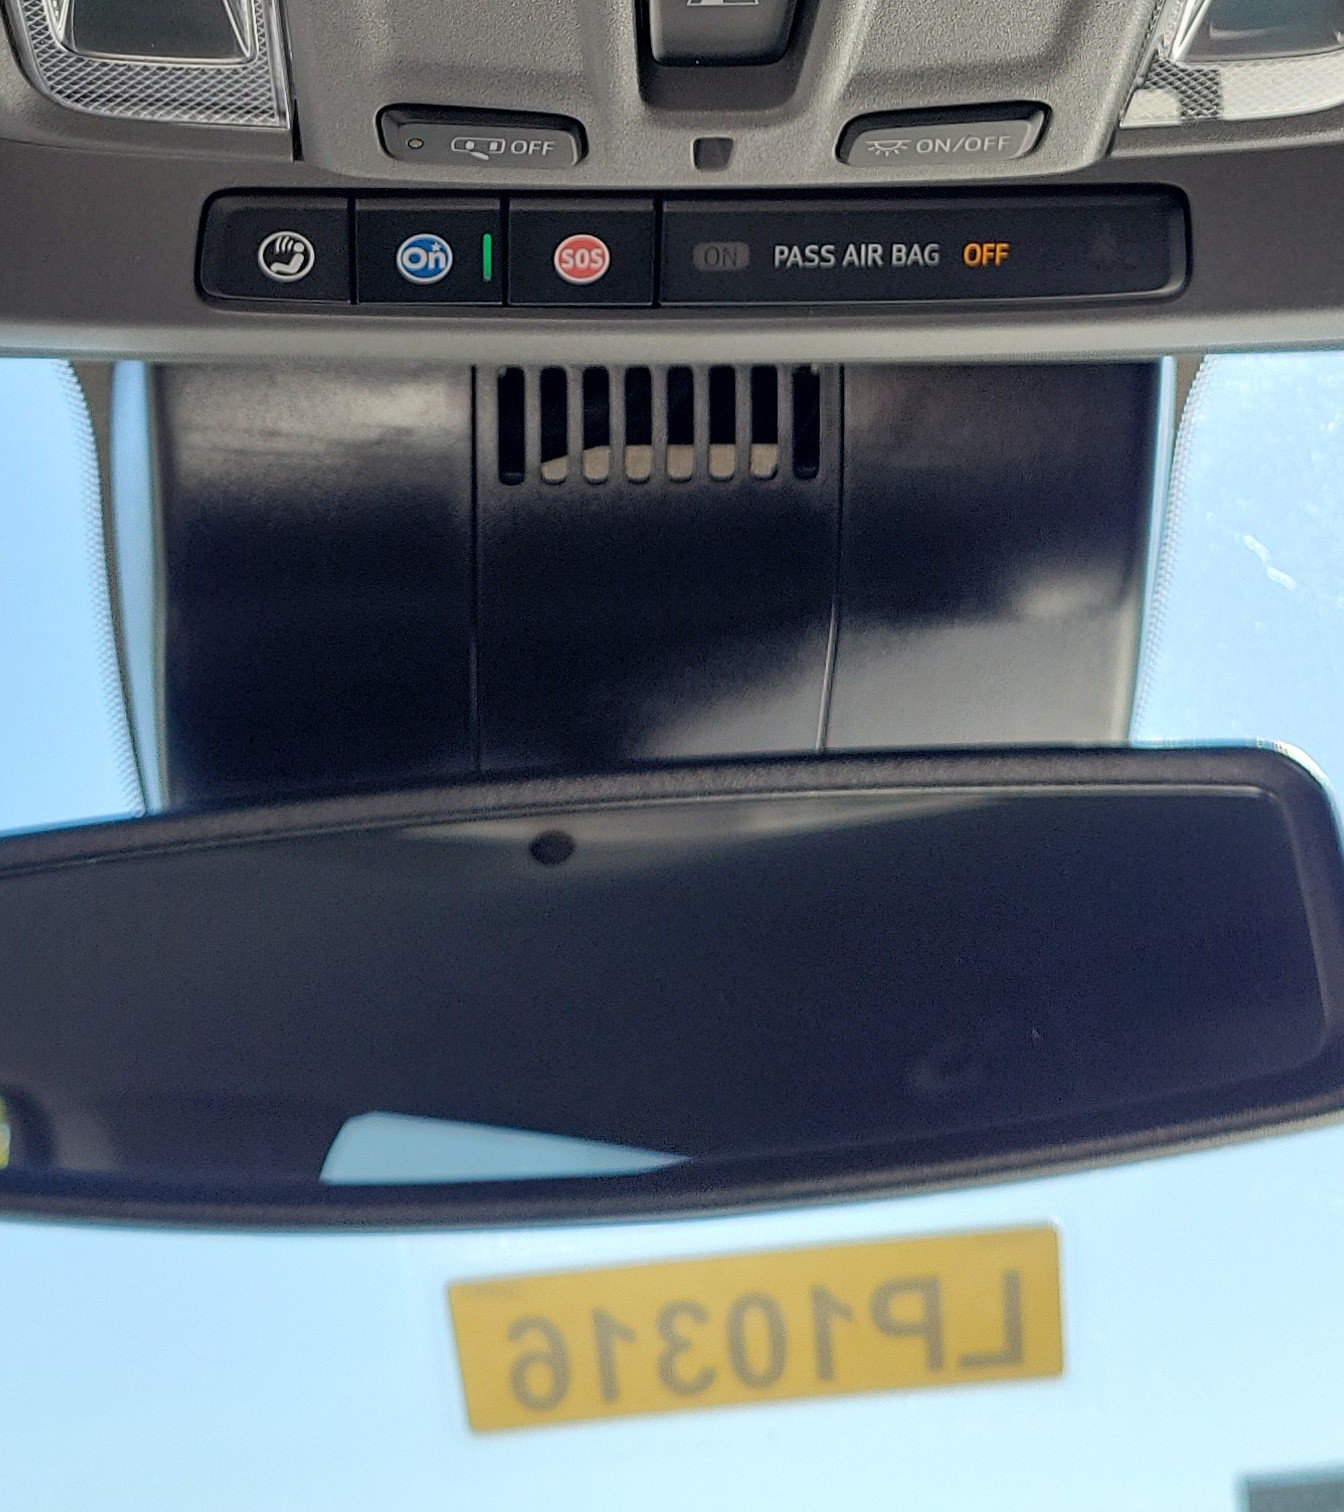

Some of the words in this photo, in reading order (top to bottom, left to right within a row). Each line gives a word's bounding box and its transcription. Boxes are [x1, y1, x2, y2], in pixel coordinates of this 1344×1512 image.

[509, 140, 555, 157] OFF
[914, 134, 1011, 156] ON/OFF
[401, 241, 448, 271] On
[560, 247, 603, 269] SOS
[704, 245, 738, 267] ON
[774, 244, 835, 267] PASS
[842, 243, 883, 266] AIR
[891, 243, 940, 265] BAG
[963, 242, 1010, 266] OFF
